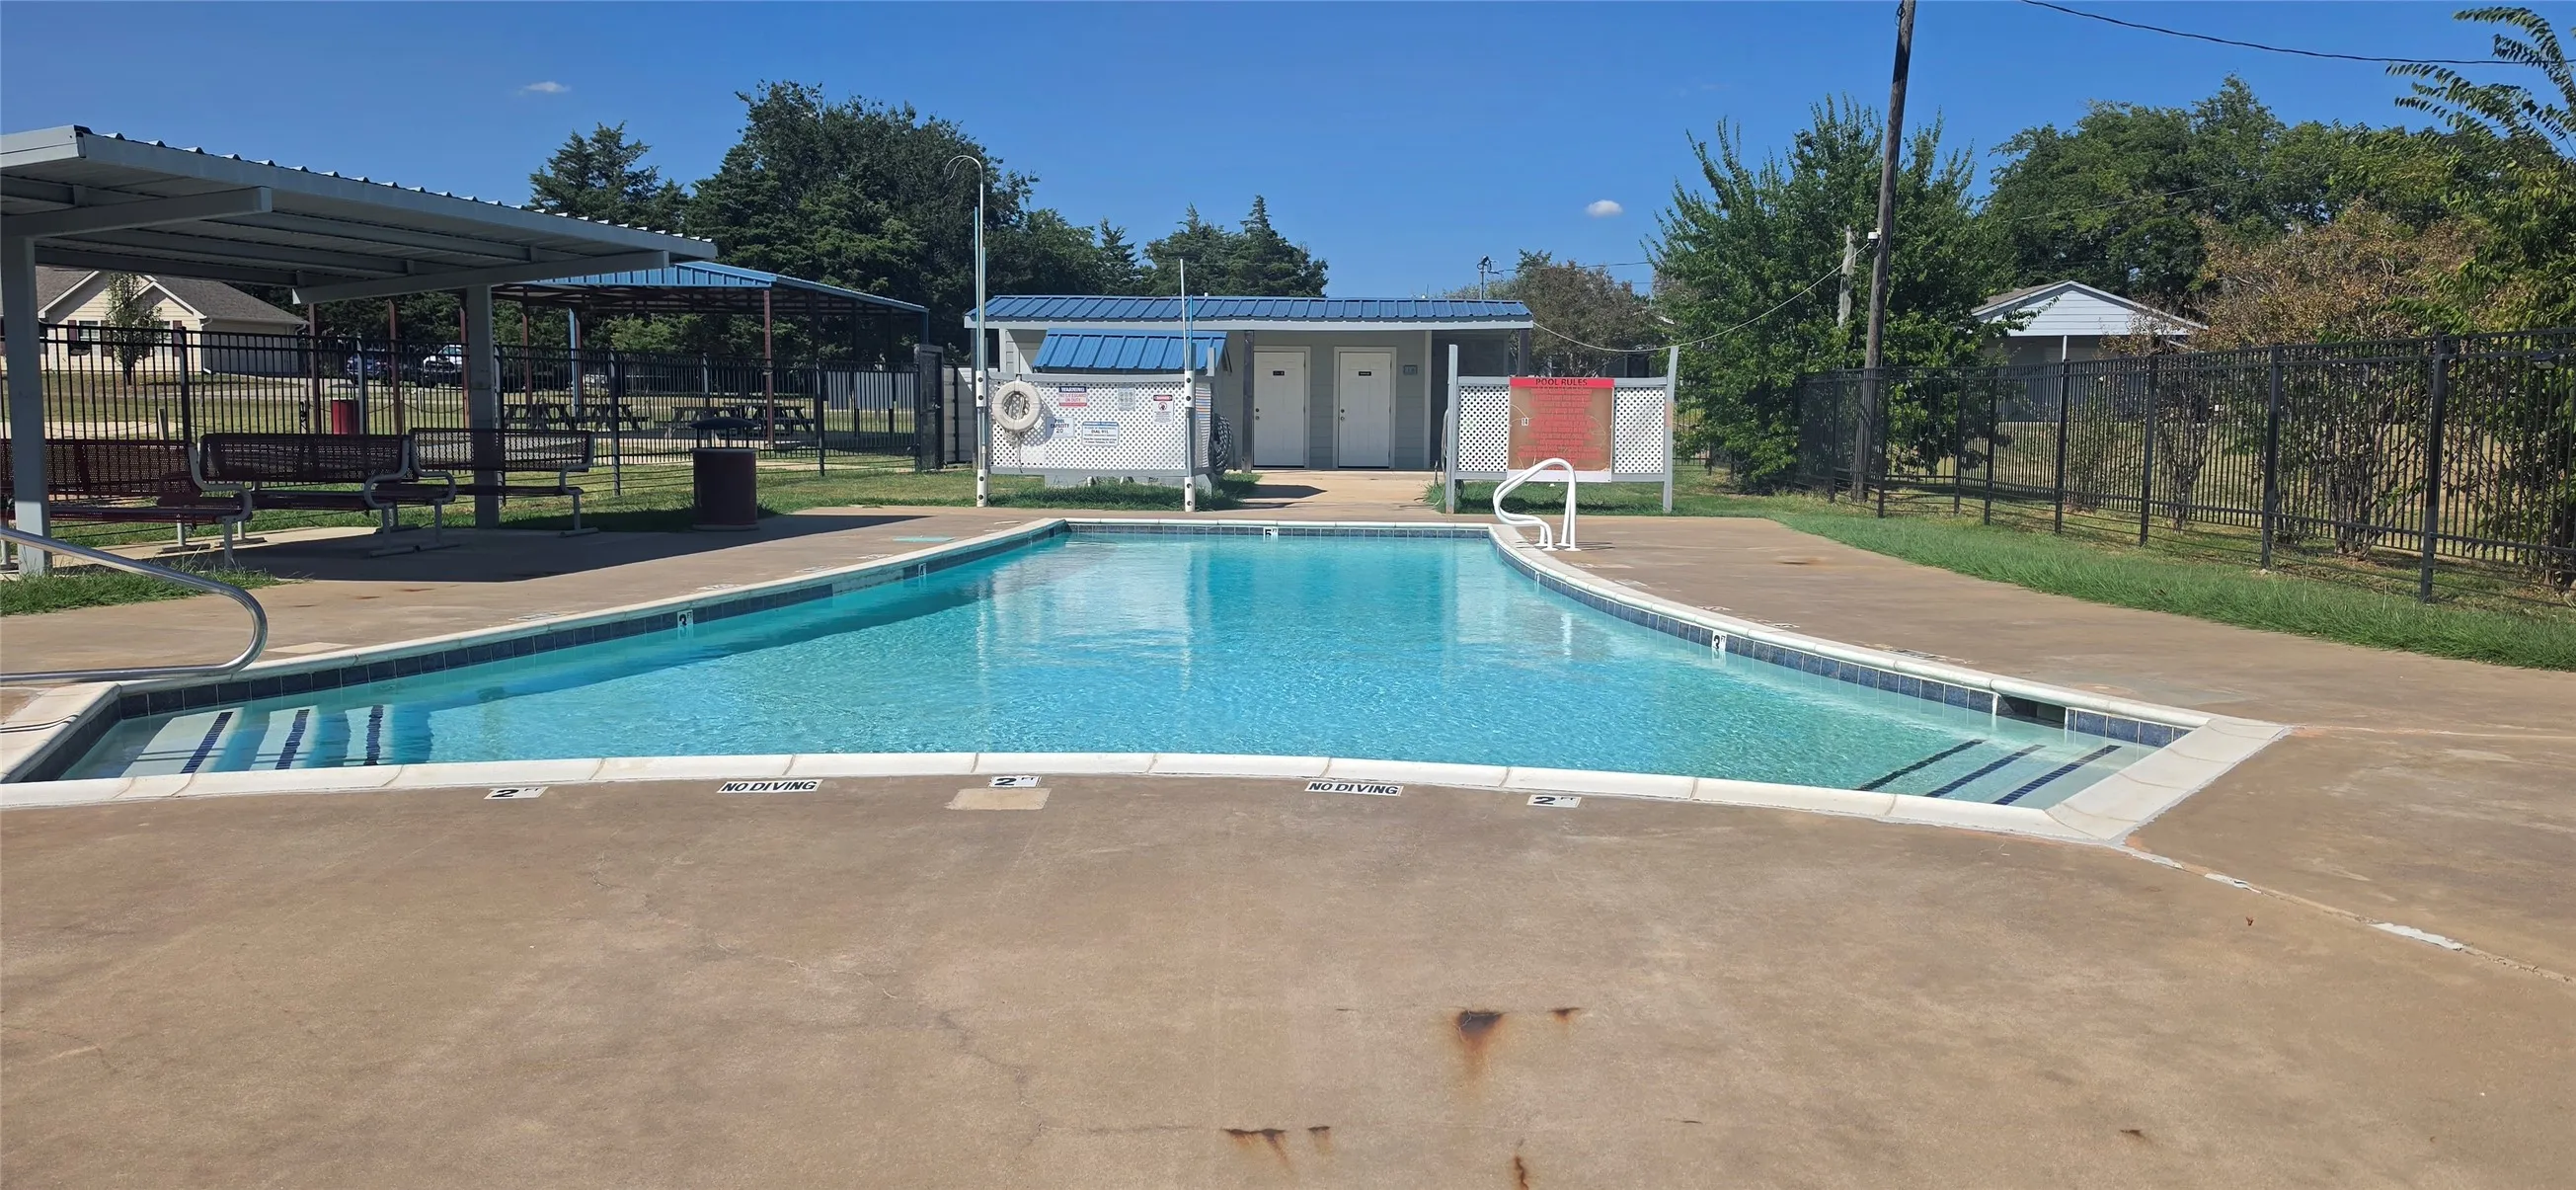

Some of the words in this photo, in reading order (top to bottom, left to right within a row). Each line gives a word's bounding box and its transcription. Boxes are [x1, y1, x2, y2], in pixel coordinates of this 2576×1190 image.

[1713, 635, 1720, 650] 3
[721, 782, 749, 792] NO
[749, 781, 818, 791] DIVING
[994, 777, 1017, 786] 2
[491, 789, 519, 798] 2
[1308, 782, 1333, 791] NO
[1335, 783, 1399, 795] DIVING
[1532, 796, 1556, 806] 2
